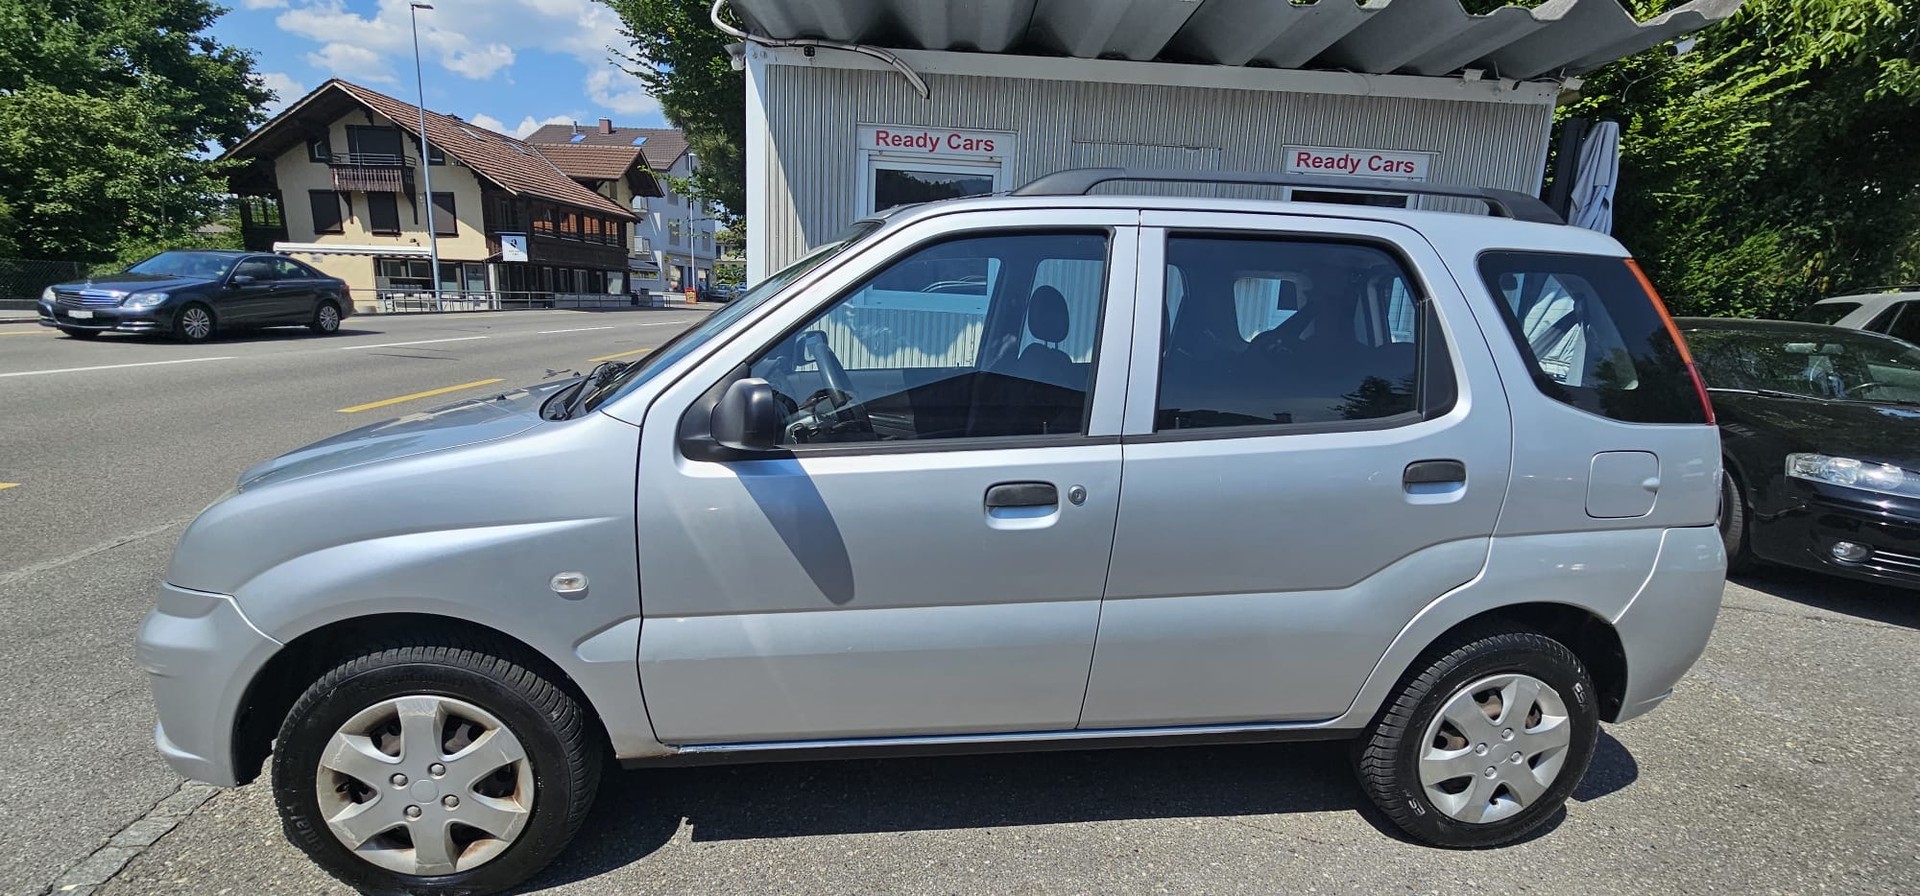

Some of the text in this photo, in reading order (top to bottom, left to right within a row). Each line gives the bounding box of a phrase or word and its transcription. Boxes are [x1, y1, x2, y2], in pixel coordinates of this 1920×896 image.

[875, 130, 995, 152] Ready Cars
[1296, 152, 1415, 174] Ready Cars
